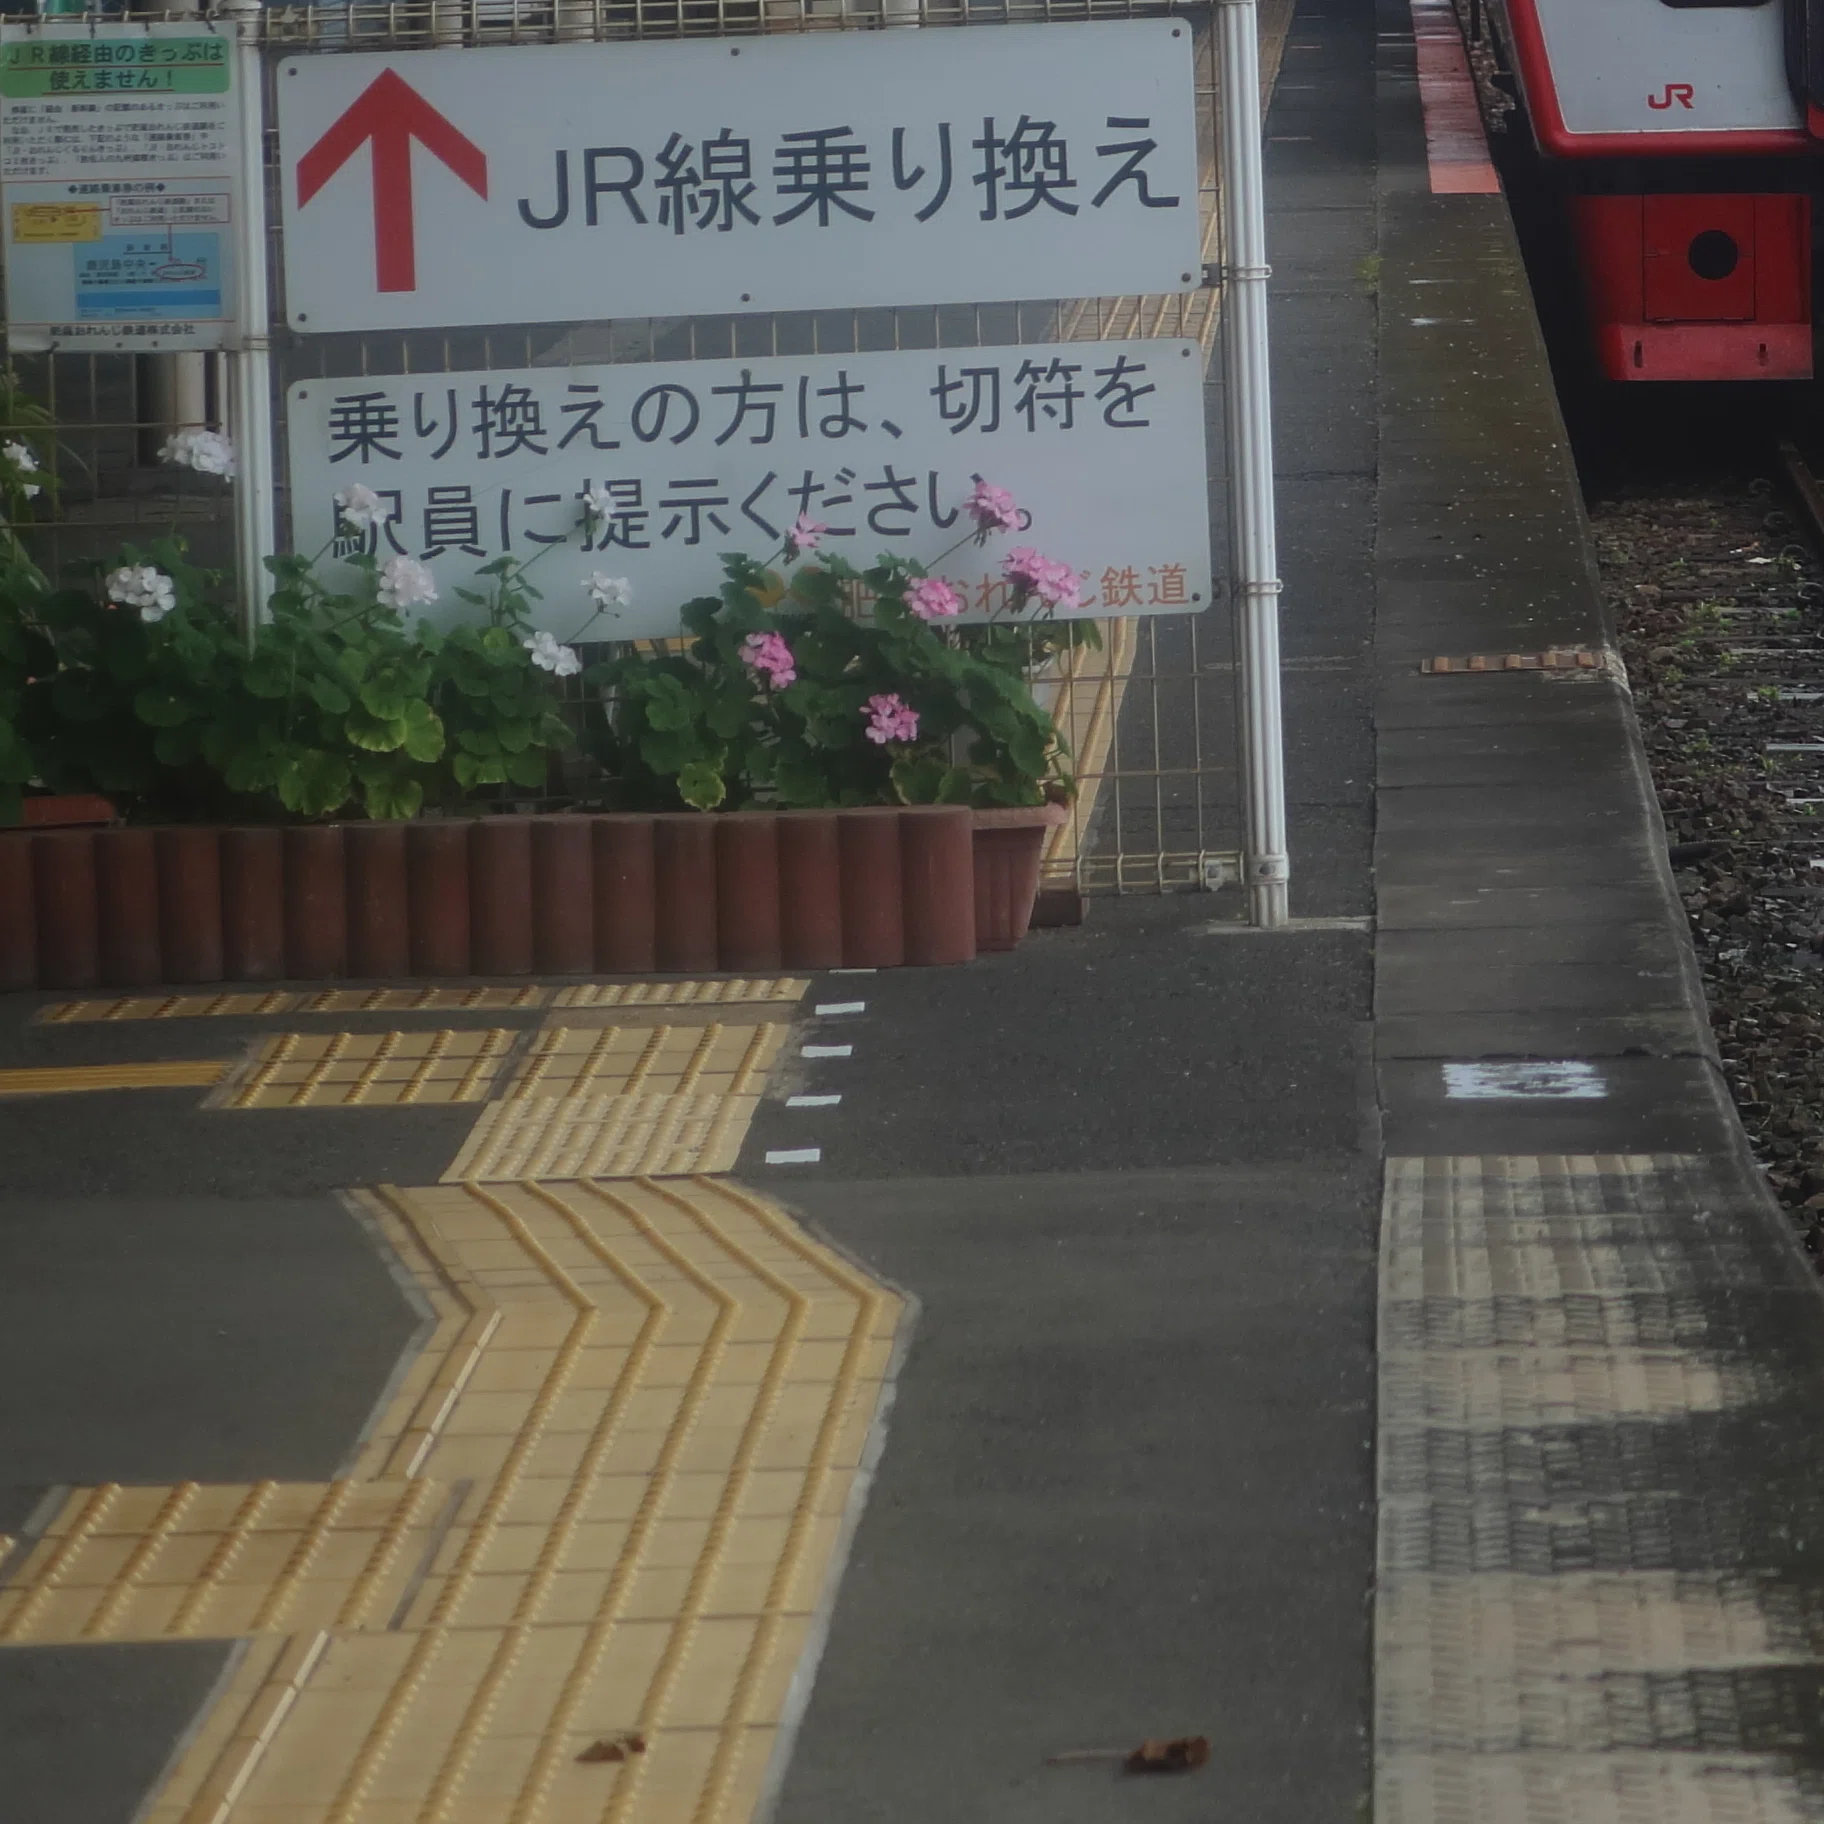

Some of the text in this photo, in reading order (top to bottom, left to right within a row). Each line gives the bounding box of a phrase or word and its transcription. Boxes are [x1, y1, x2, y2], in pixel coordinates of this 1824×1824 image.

[1647, 84, 1695, 110] JR
[517, 114, 1181, 235] JR線乗り換え
[328, 355, 1157, 464] 乗り換えの方は、切符を
